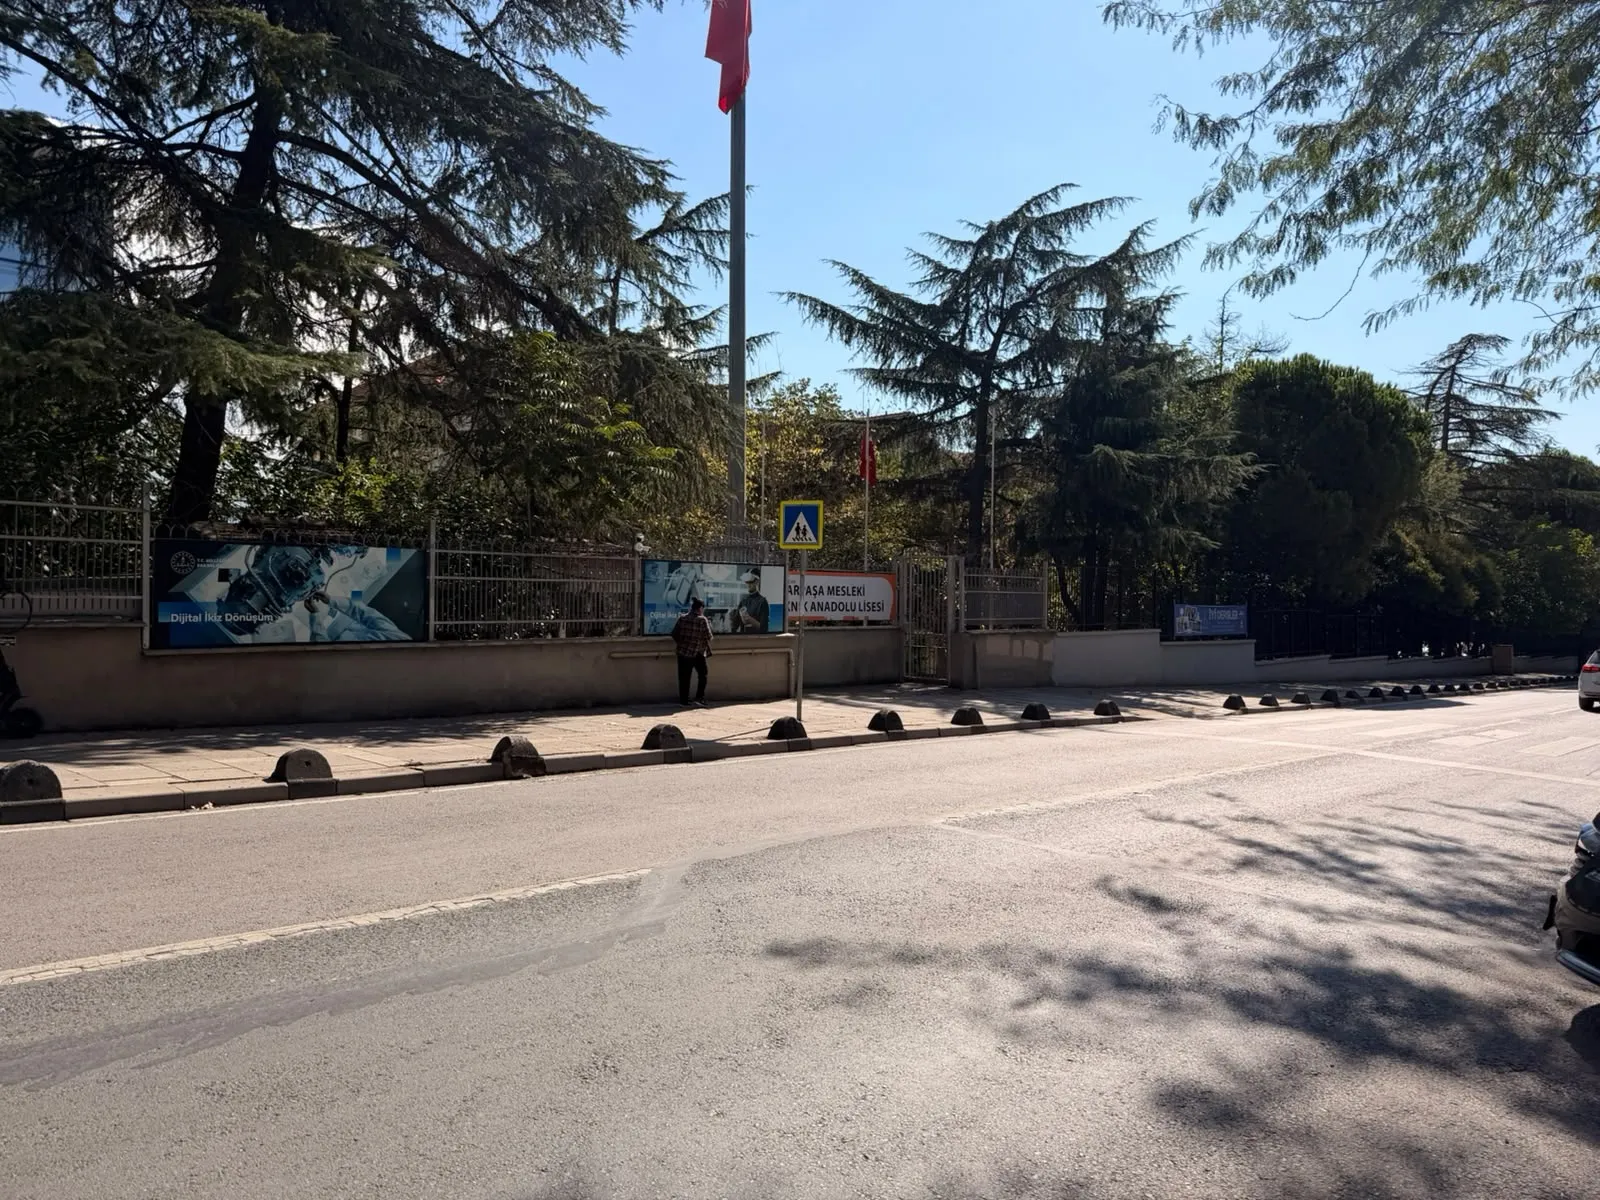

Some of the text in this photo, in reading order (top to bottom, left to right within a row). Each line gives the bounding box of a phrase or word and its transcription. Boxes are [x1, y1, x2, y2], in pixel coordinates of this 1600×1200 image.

[827, 584, 866, 597] MESLEKİ
[810, 600, 856, 612] ANADOLU
[858, 600, 885, 612] LİSESİ
[170, 611, 274, 624] Dijital İkiz Dönüşüm
